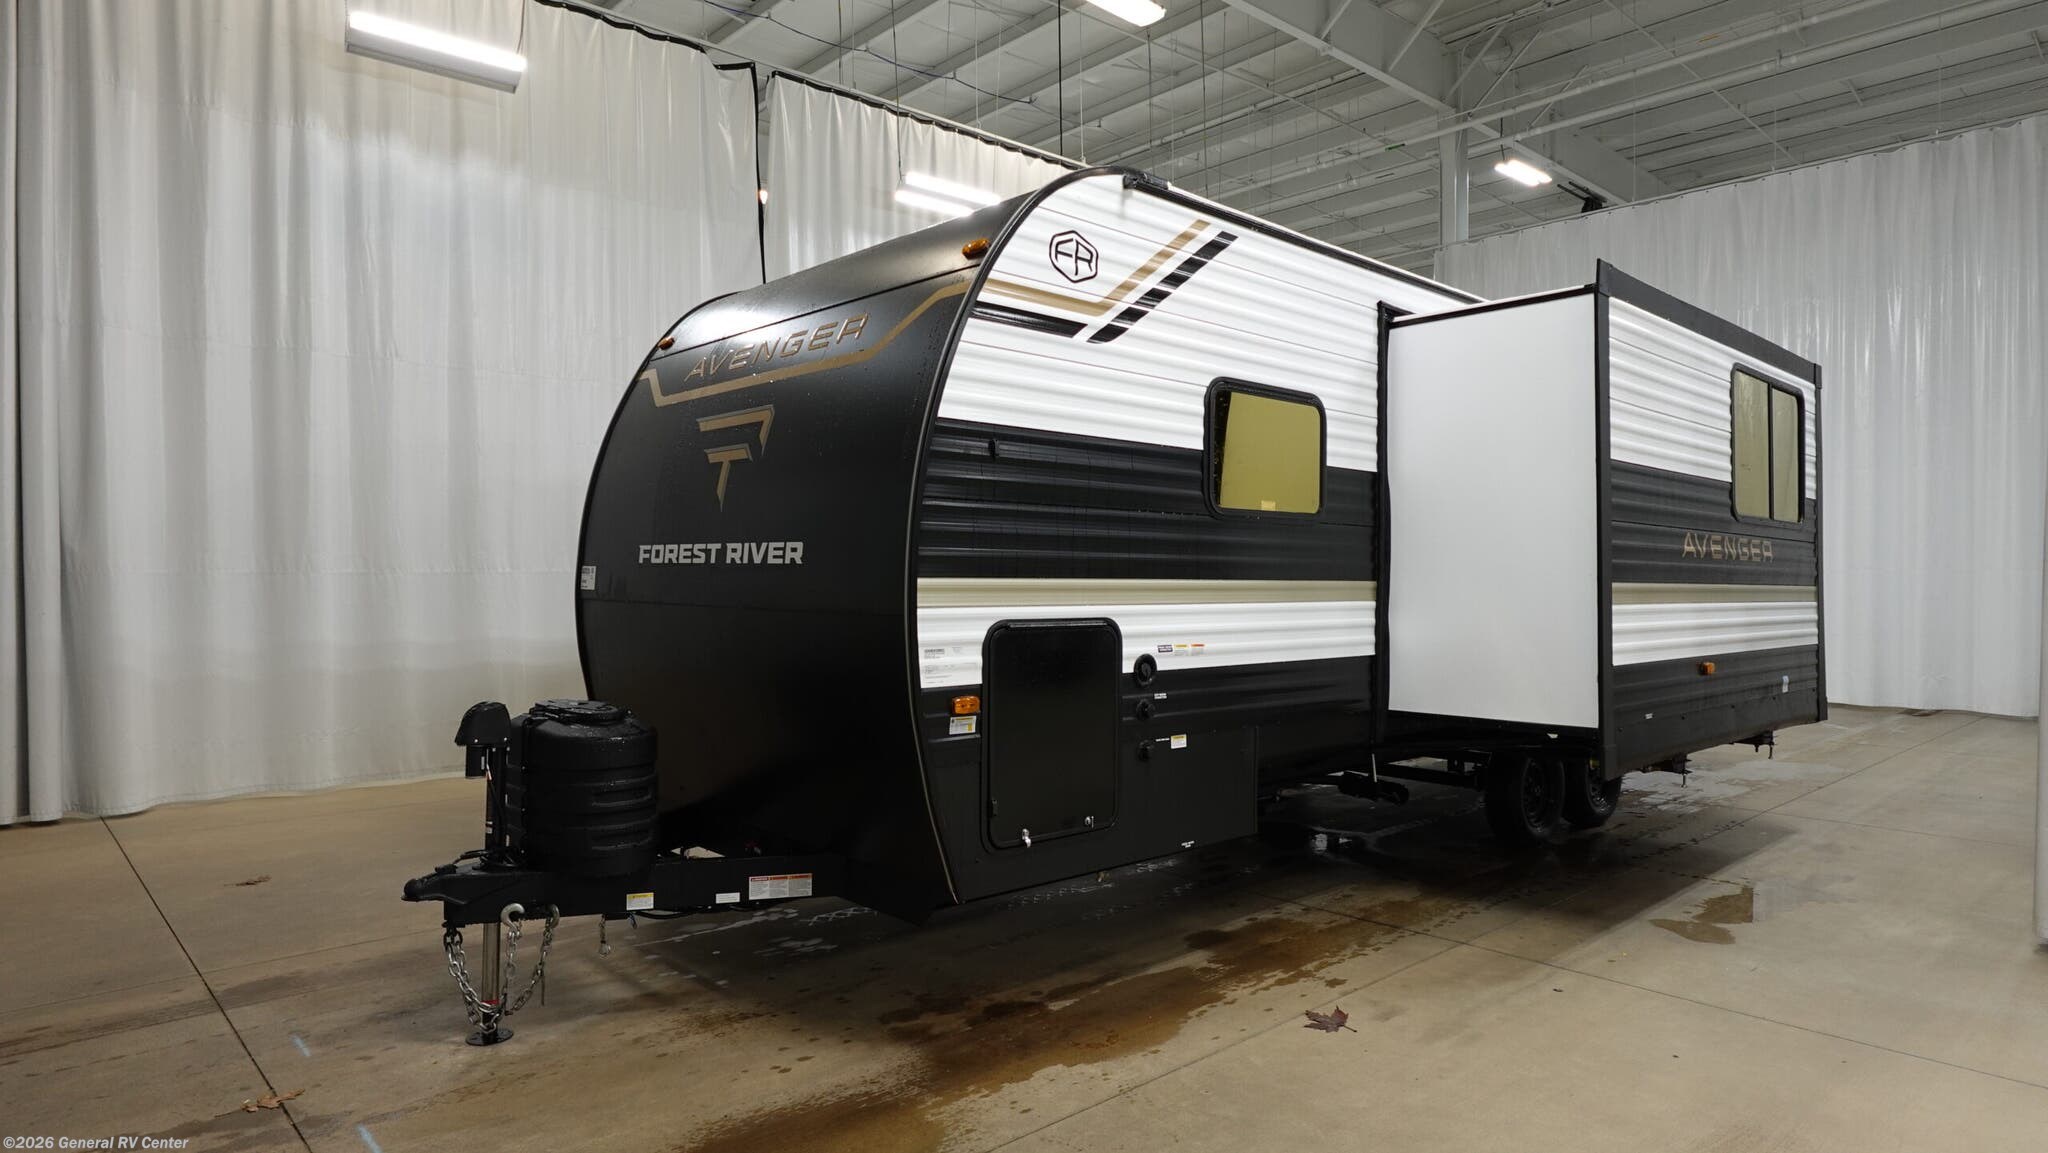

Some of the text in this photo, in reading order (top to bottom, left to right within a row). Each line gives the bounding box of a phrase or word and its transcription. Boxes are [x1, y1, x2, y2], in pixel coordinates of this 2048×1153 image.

[684, 312, 870, 382] AVENGER
[638, 541, 804, 565] FOREST RIVER
[1682, 531, 1774, 563] AVENGER
